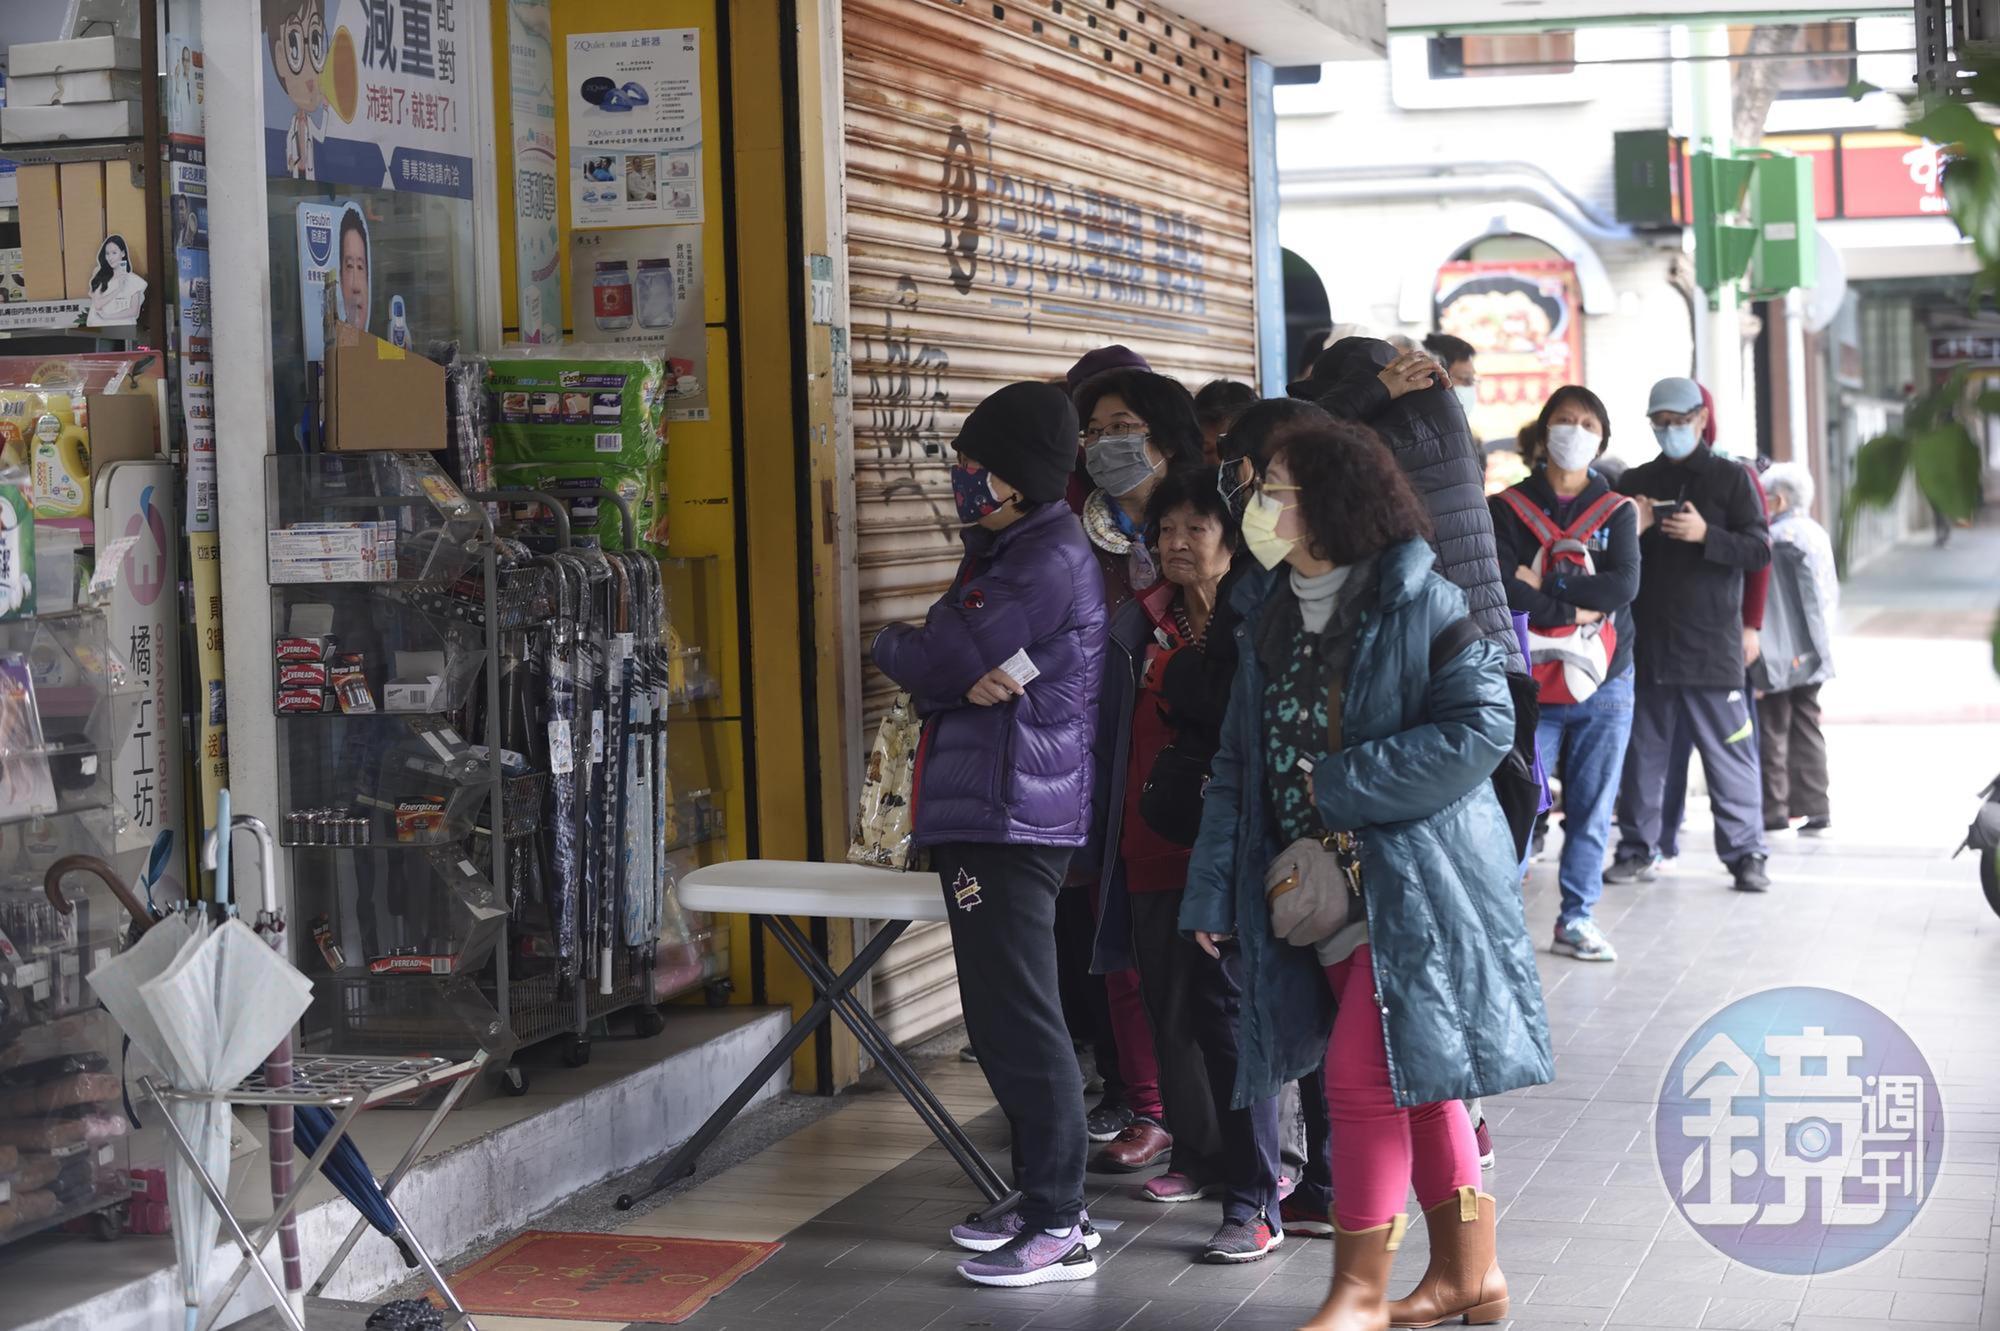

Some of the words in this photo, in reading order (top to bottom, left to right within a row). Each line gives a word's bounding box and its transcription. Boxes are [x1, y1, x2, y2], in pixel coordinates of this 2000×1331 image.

[358, 0, 435, 79] 減重
[305, 211, 331, 227] Fresubin
[283, 646, 312, 654] EVEREADY
[155, 622, 167, 731] ORANGE
[287, 671, 316, 679] EVEREADY
[284, 696, 312, 704] EVEREADY
[157, 739, 168, 825] HOUSE
[398, 801, 442, 813] Energizer
[390, 958, 424, 968] EVEREADY
